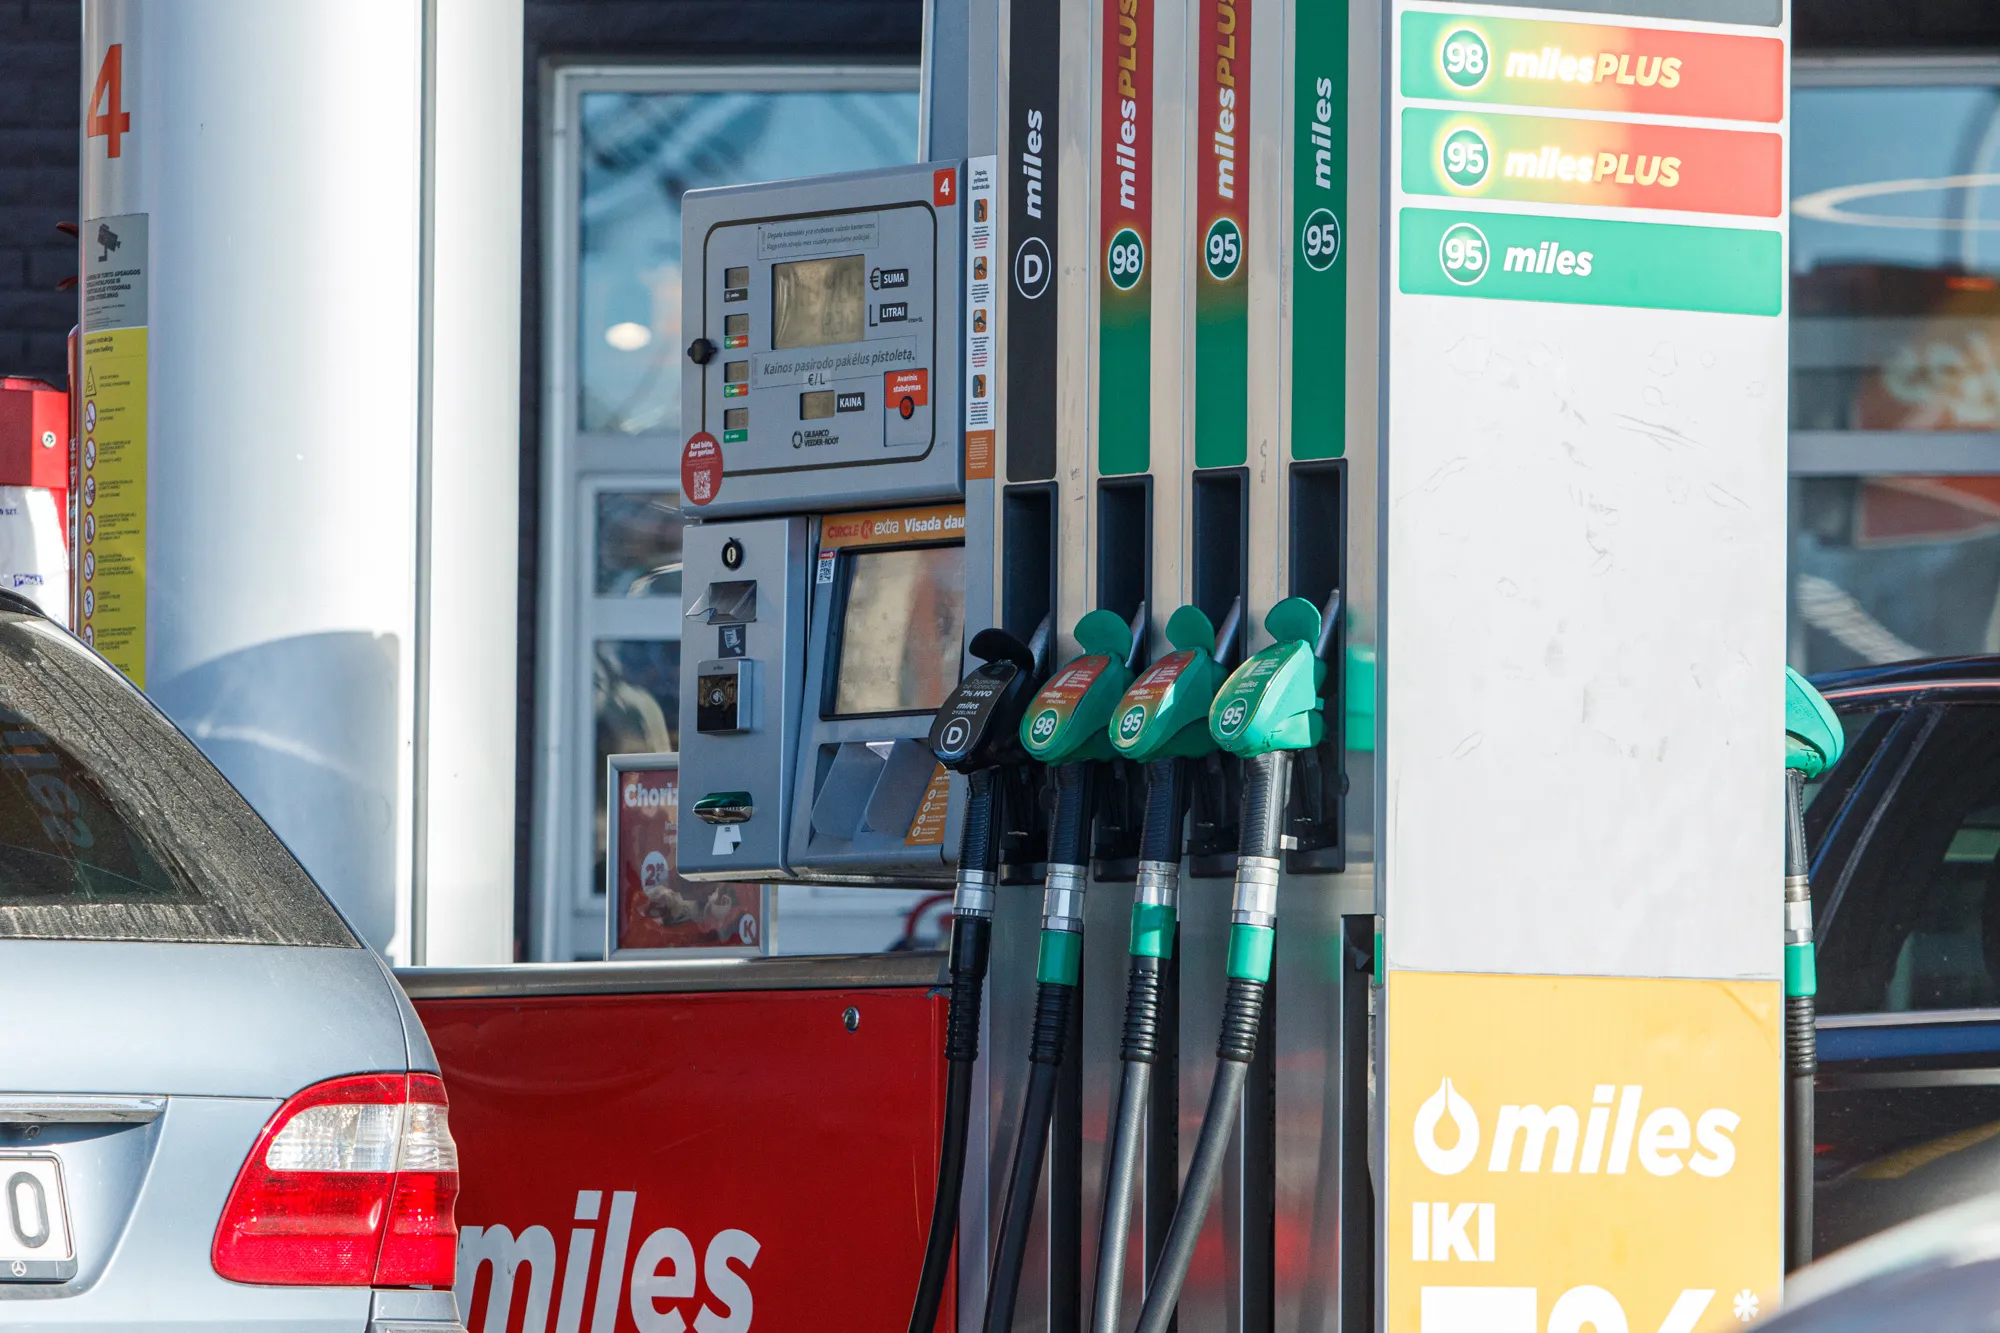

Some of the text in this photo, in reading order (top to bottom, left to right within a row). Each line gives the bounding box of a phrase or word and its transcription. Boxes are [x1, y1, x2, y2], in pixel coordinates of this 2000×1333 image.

[1446, 42, 1683, 89] 98 milesPLUS
[88, 44, 130, 158] 4
[1214, 0, 1237, 200] milesPLU
[1311, 77, 1333, 190] miles
[1023, 109, 1043, 219] miles
[1447, 142, 1682, 188] 95 milesPLUS
[940, 177, 950, 196] 4
[1209, 233, 1237, 265] 95
[1306, 223, 1335, 257] 95
[1023, 254, 1043, 284] D
[1112, 243, 1140, 275] 98
[1445, 239, 1594, 277] 95 miles
[883, 273, 905, 284] SUMA
[882, 307, 905, 318] LITRAI
[764, 363, 792, 375] Kainos
[794, 358, 834, 375] pasirodo
[835, 353, 870, 370] pakėlus
[871, 349, 916, 366] pistoletą.
[893, 385, 921, 393] stabdymas
[897, 374, 918, 382] Avarinis
[839, 397, 862, 408] KAINA
[804, 429, 830, 438] GILBARCO
[804, 437, 839, 447] VEEDER-ROOT
[828, 524, 859, 539] CIRCLE
[874, 519, 899, 535] extra
[904, 516, 942, 533] Visada
[1033, 717, 1055, 735] 98
[1122, 713, 1143, 732] 95
[1222, 707, 1245, 725] 95
[946, 727, 963, 744] D
[645, 864, 656, 886] 2
[1488, 1084, 1741, 1178] miles
[1412, 1201, 1496, 1262] IKI
[454, 1190, 761, 1333] miles
